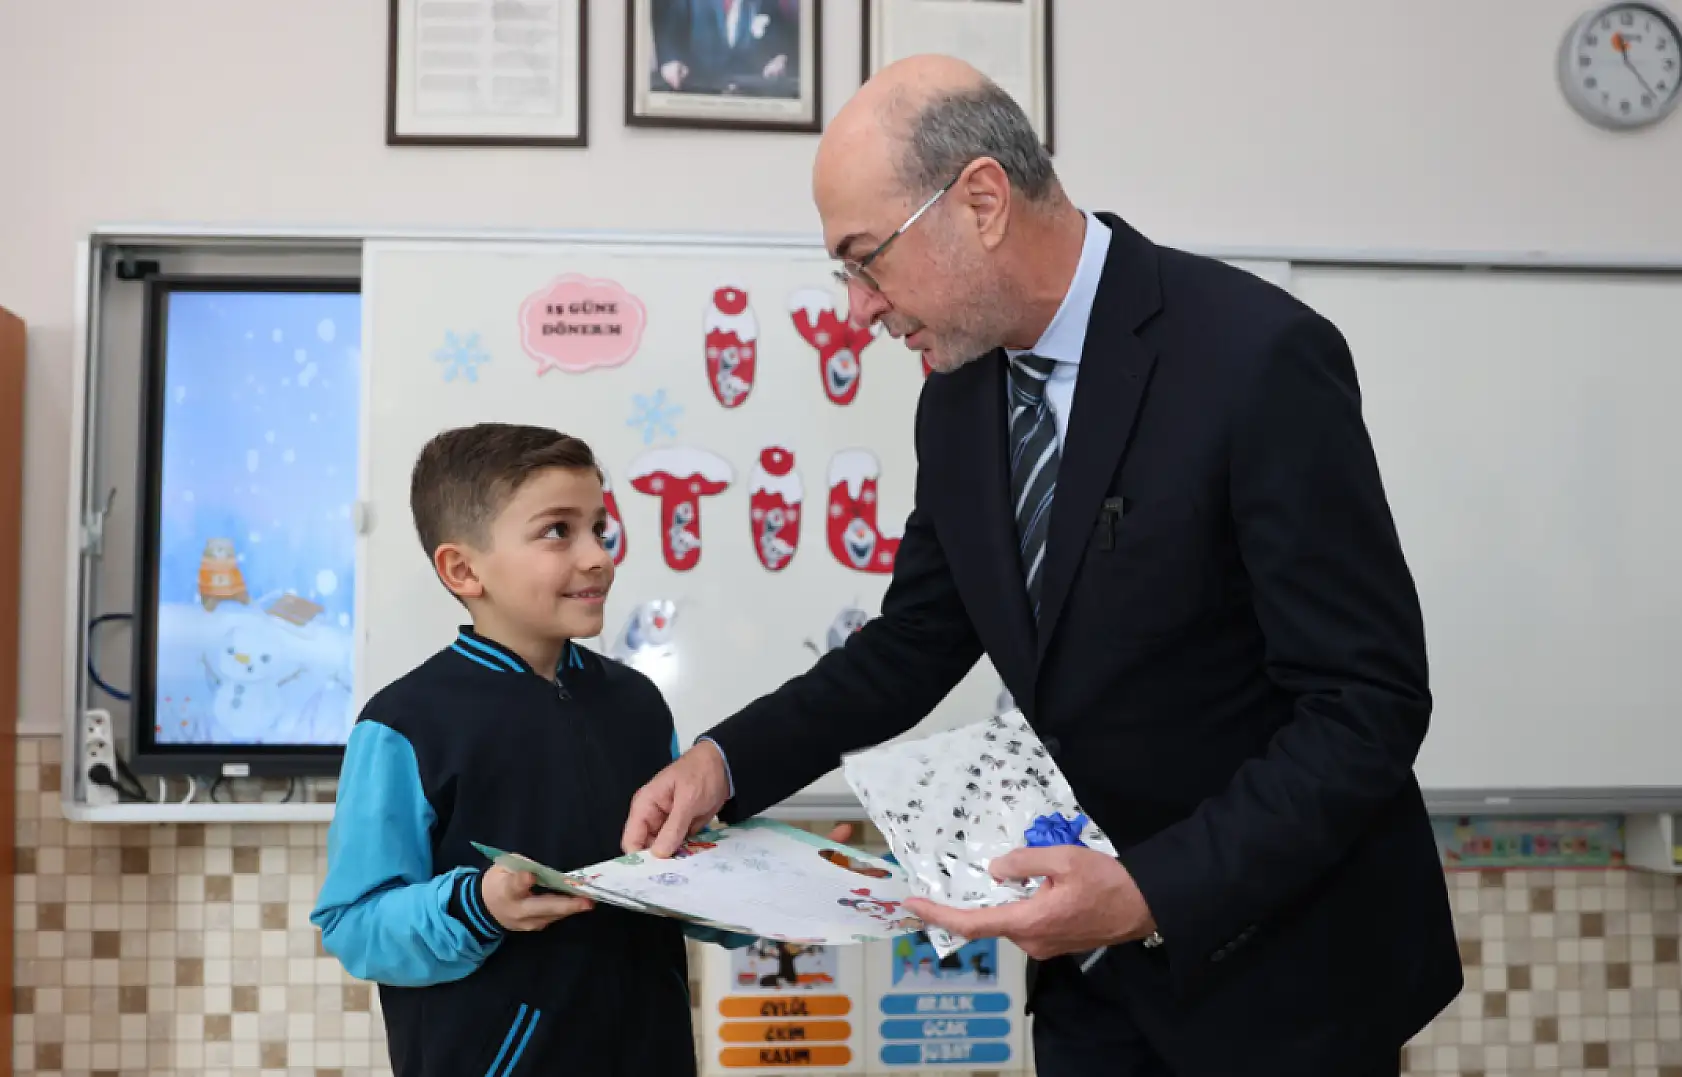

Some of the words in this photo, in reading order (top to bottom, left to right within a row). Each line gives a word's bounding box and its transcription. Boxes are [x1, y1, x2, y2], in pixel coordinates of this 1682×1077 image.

[545, 302, 565, 315] 15
[568, 299, 618, 315] GÜNE
[703, 284, 932, 408] İY
[603, 444, 906, 575] TİL
[922, 1020, 968, 1036] OCAK
[760, 1047, 811, 1064] KASIM
